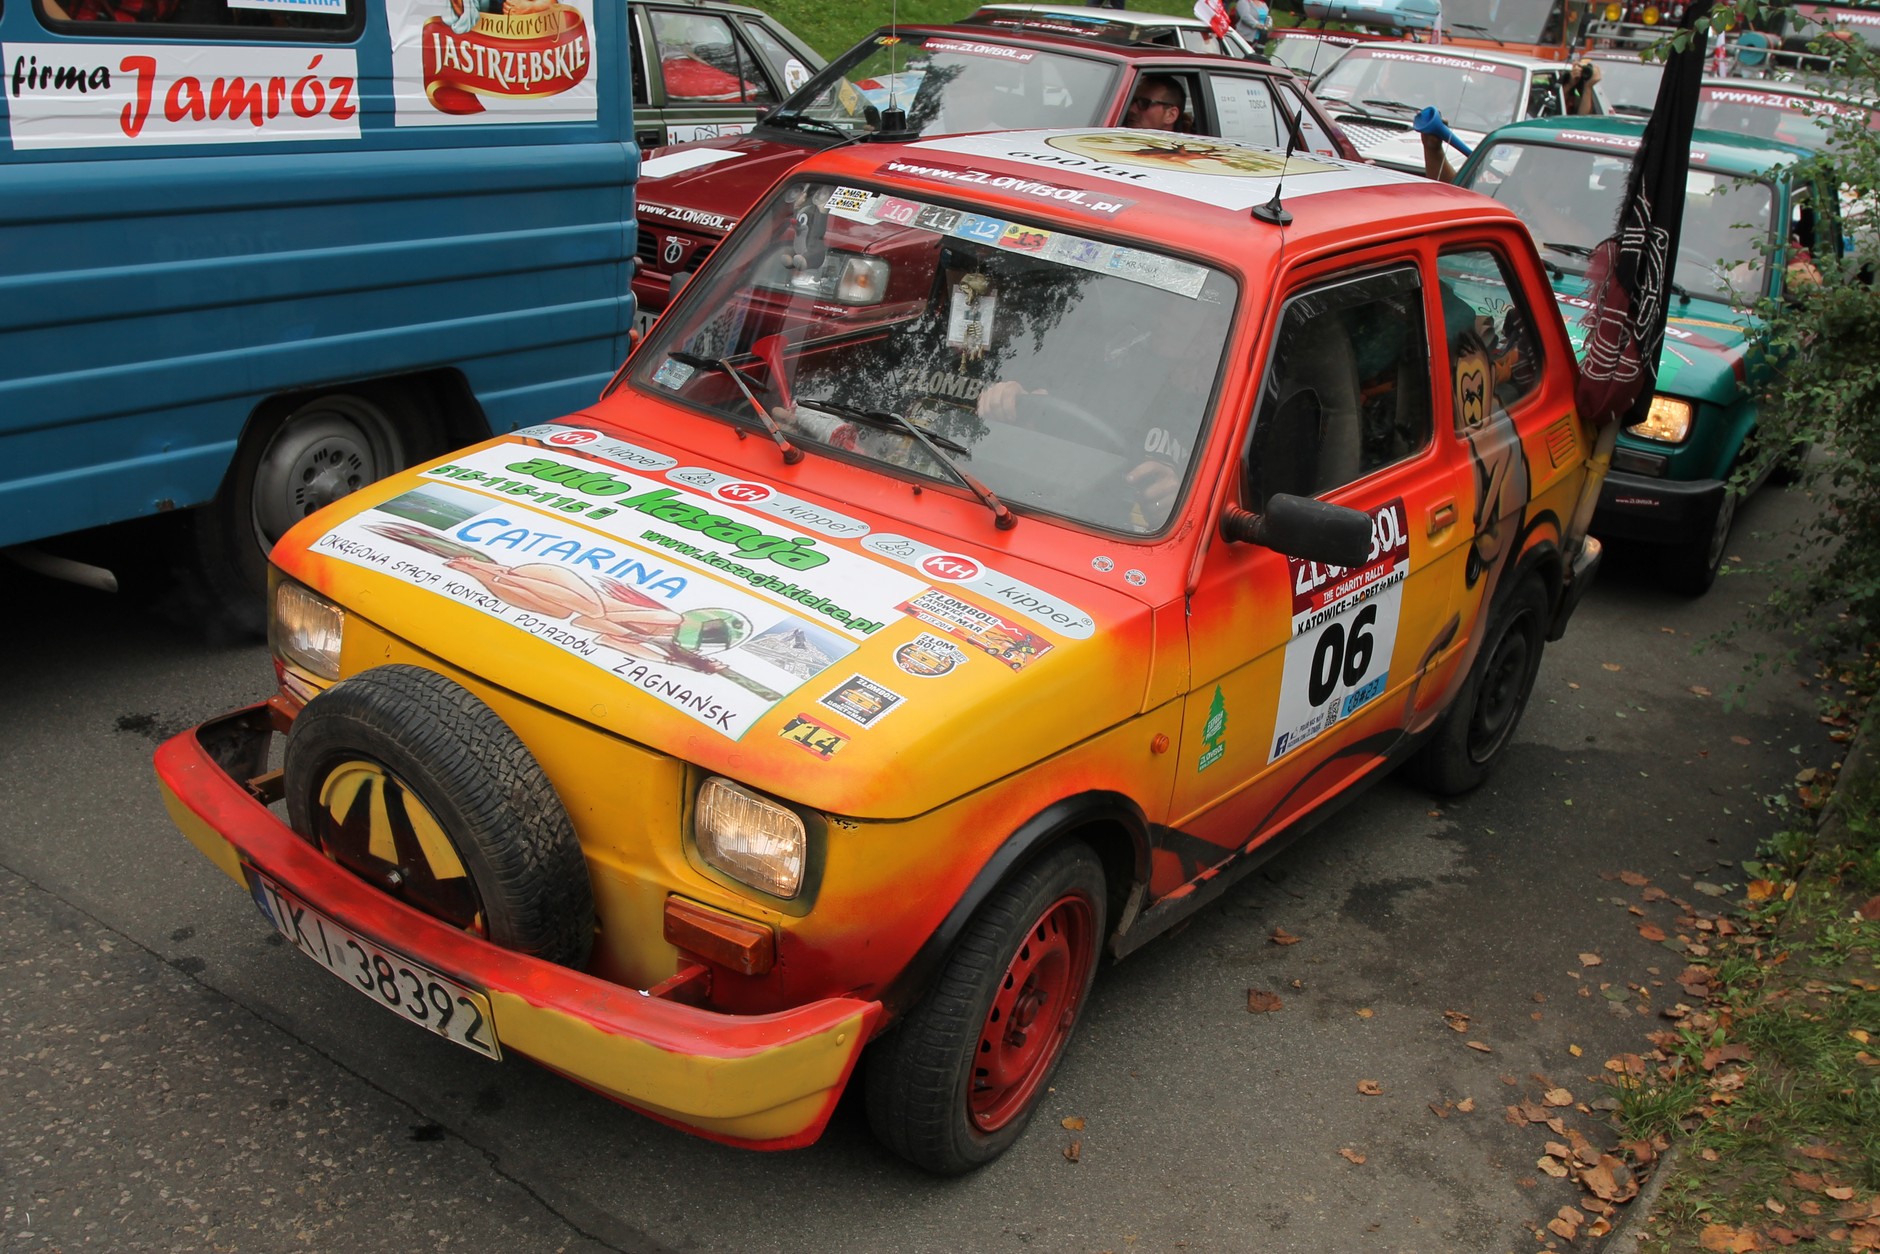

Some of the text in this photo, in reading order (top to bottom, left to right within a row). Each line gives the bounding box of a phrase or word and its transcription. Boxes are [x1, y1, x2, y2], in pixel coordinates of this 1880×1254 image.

[480, 9, 562, 42] makarony
[432, 32, 586, 91] JASTRZĘBSKIE
[11, 53, 356, 138] firma Jamróz
[888, 160, 1123, 213] www.ZLOMBOL.pl
[885, 203, 913, 221] 10
[924, 213, 953, 231] 11
[970, 221, 1000, 238] 12
[552, 431, 595, 446] KH
[427, 464, 587, 514] 515-115-115
[721, 484, 765, 502] KH
[505, 457, 830, 572] auto kasacja
[456, 517, 688, 600] CATARINA
[926, 556, 975, 579] KH
[638, 528, 886, 636] www.kasacjakielce.pl
[1323, 564, 1385, 602] THE CHARITY RALLY
[920, 595, 966, 618] KATOWICE
[319, 534, 737, 731] OKRĘGOWA STACJA KONTROLI POJAZDÓW ZAGNAŃSK
[935, 620, 954, 631] 2014
[956, 618, 983, 633] MAR
[1308, 604, 1378, 708] 06
[851, 712, 867, 723] MAR
[793, 724, 841, 757] 14
[263, 881, 492, 1053] TKI 38392
